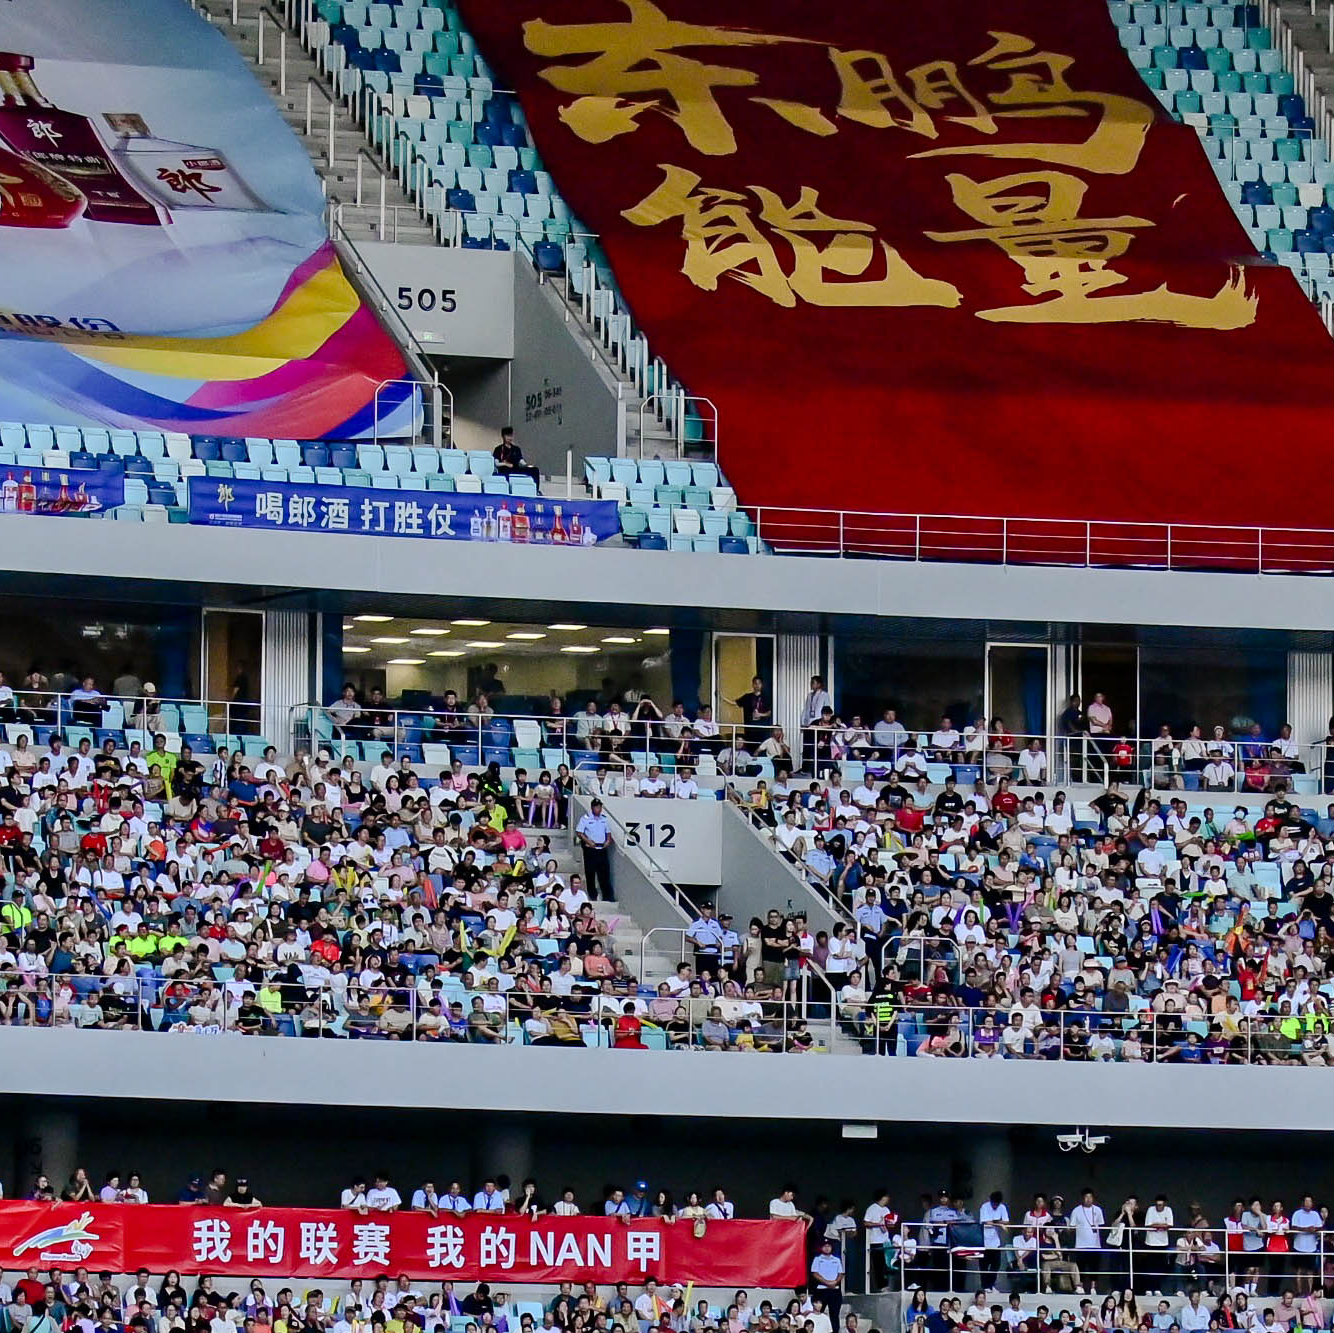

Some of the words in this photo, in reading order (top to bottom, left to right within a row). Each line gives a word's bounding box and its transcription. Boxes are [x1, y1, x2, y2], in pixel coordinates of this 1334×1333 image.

[620, 164, 1259, 330] 能量
[397, 286, 457, 313] 505
[255, 492, 349, 529] 喝郎酒
[360, 498, 457, 536] 打胜仗
[625, 822, 676, 848] 312
[192, 1217, 392, 1267] 我的联赛
